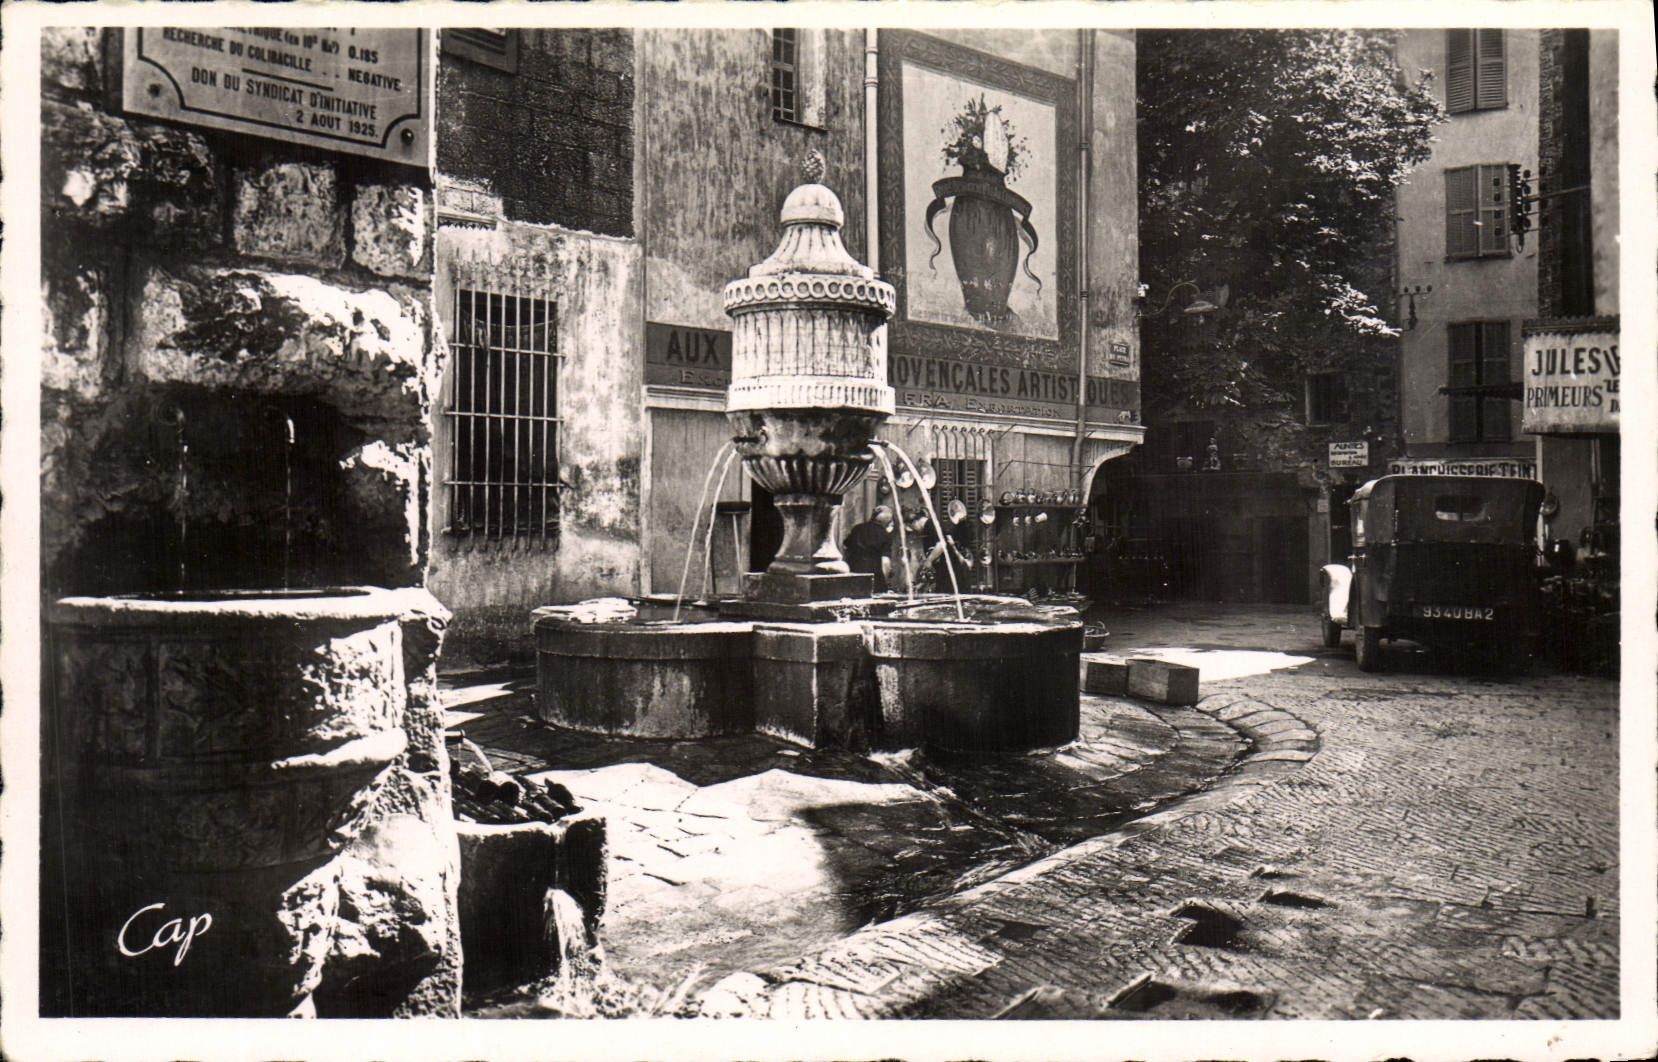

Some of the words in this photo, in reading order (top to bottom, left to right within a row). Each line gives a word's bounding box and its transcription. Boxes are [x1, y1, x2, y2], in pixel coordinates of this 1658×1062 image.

[163, 27, 224, 52] RECHERCHE
[229, 41, 243, 57] DU
[248, 45, 312, 72] COLIBACILLE
[348, 68, 402, 92] NEGATIVE
[192, 66, 217, 87] DON
[224, 73, 240, 92] DU
[246, 79, 304, 105] SYNDICAT
[310, 91, 377, 120] D'INITIATIVE
[296, 109, 304, 123] 2
[311, 112, 341, 130] AOUT
[666, 330, 719, 364] AUX
[887, 355, 1010, 394] ROVENÇALES
[1017, 370, 1130, 407] ARTISTQUES
[1531, 346, 1602, 376] JULES
[1526, 385, 1603, 408] PRIMEURS
